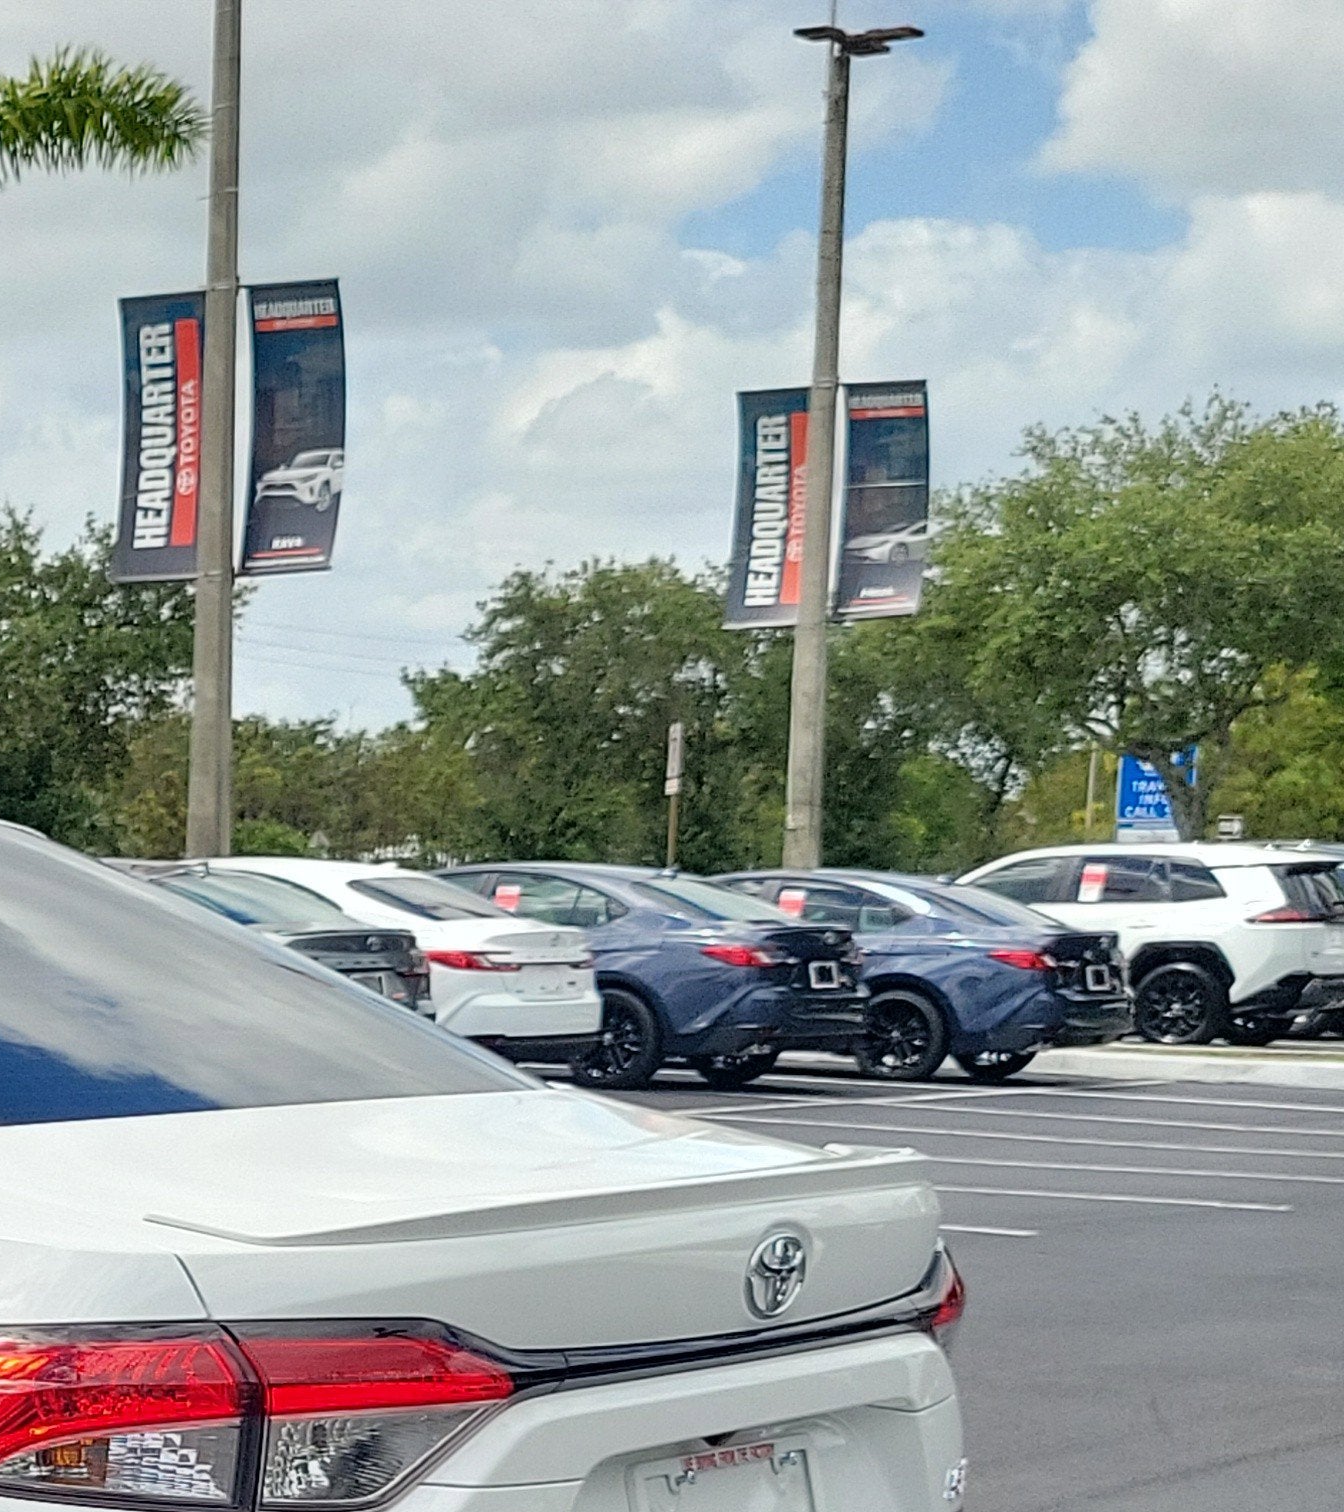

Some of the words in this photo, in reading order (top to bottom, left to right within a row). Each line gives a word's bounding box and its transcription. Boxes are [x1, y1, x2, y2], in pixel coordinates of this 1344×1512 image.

[132, 321, 176, 549] HEADQUARTER
[178, 379, 199, 466] TOYOTA
[743, 414, 789, 607] HEADQUARTER
